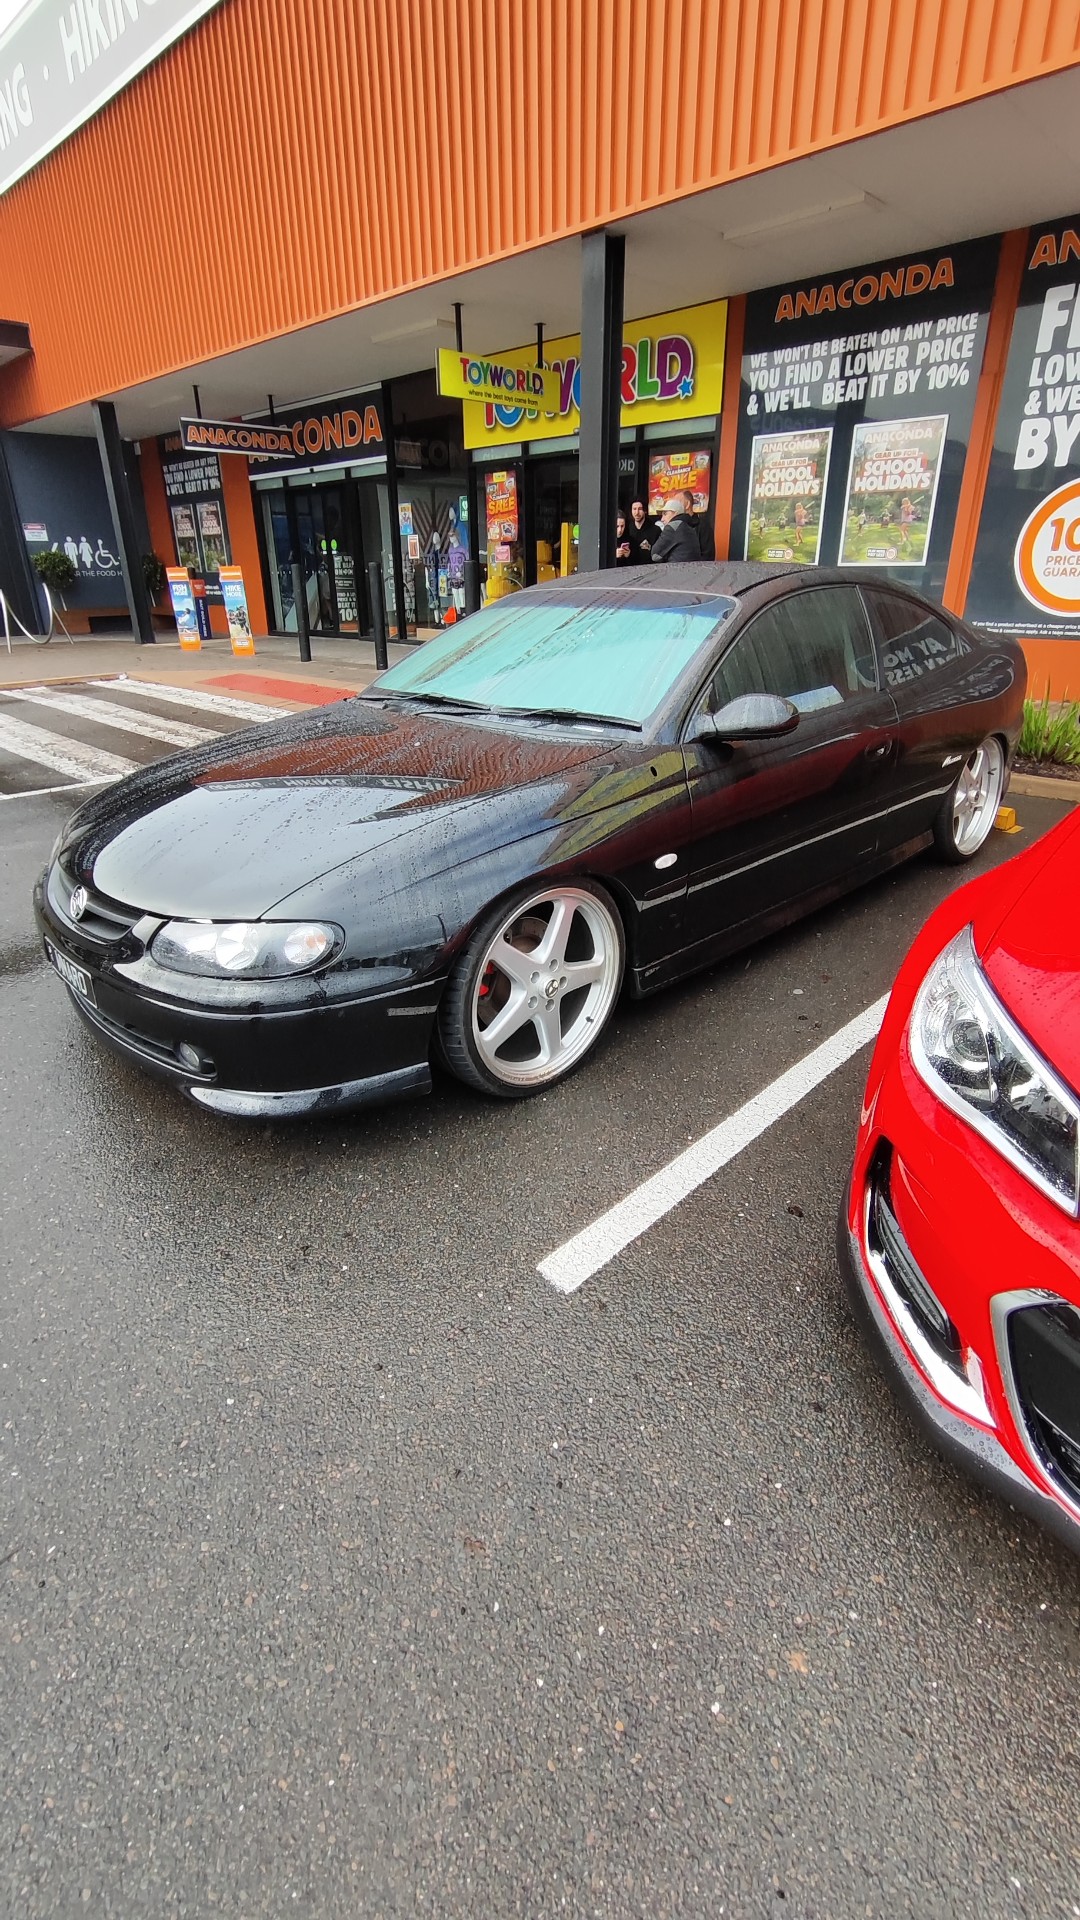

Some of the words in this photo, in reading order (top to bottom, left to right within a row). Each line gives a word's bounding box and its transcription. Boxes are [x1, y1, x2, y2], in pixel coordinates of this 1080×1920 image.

[0, 62, 34, 150] NG
[59, 0, 156, 85] HIKI
[775, 258, 955, 323] ANACONDA
[750, 352, 768, 369] WE
[773, 344, 810, 366] WON'T
[812, 341, 828, 358] BE
[831, 331, 877, 355] BEATEN
[881, 326, 900, 344] ON
[903, 320, 934, 342] ANY
[935, 312, 980, 336] PRICE
[749, 366, 782, 392] YOU
[784, 359, 824, 387] FIND
[827, 357, 841, 380] A
[844, 344, 910, 378] LOWER
[915, 333, 977, 366] PRICE
[460, 357, 544, 395] TOYWORLD
[469, 389, 483, 397] where
[493, 392, 503, 400] best
[504, 395, 513, 403] toys
[528, 398, 538, 406] from
[746, 394, 759, 416] &
[763, 387, 811, 413] WE'LL
[821, 375, 869, 405] BEAT
[870, 373, 890, 398] IT
[893, 367, 922, 395] BY
[925, 362, 970, 391] 10%
[1024, 389, 1041, 416] &
[187, 425, 292, 451] ANACONDA
[762, 439, 820, 453] ANACONDA
[865, 427, 933, 444] ANACONDA
[1013, 413, 1080, 470] BY
[762, 466, 813, 483] SCHOOL
[863, 458, 923, 477] SCHOOL
[660, 470, 697, 493] SALE
[755, 480, 820, 497] HOLIDAYS
[855, 473, 931, 491] HOLIDAYS
[488, 497, 515, 515] SALE
[225, 584, 242, 592] HIKE
